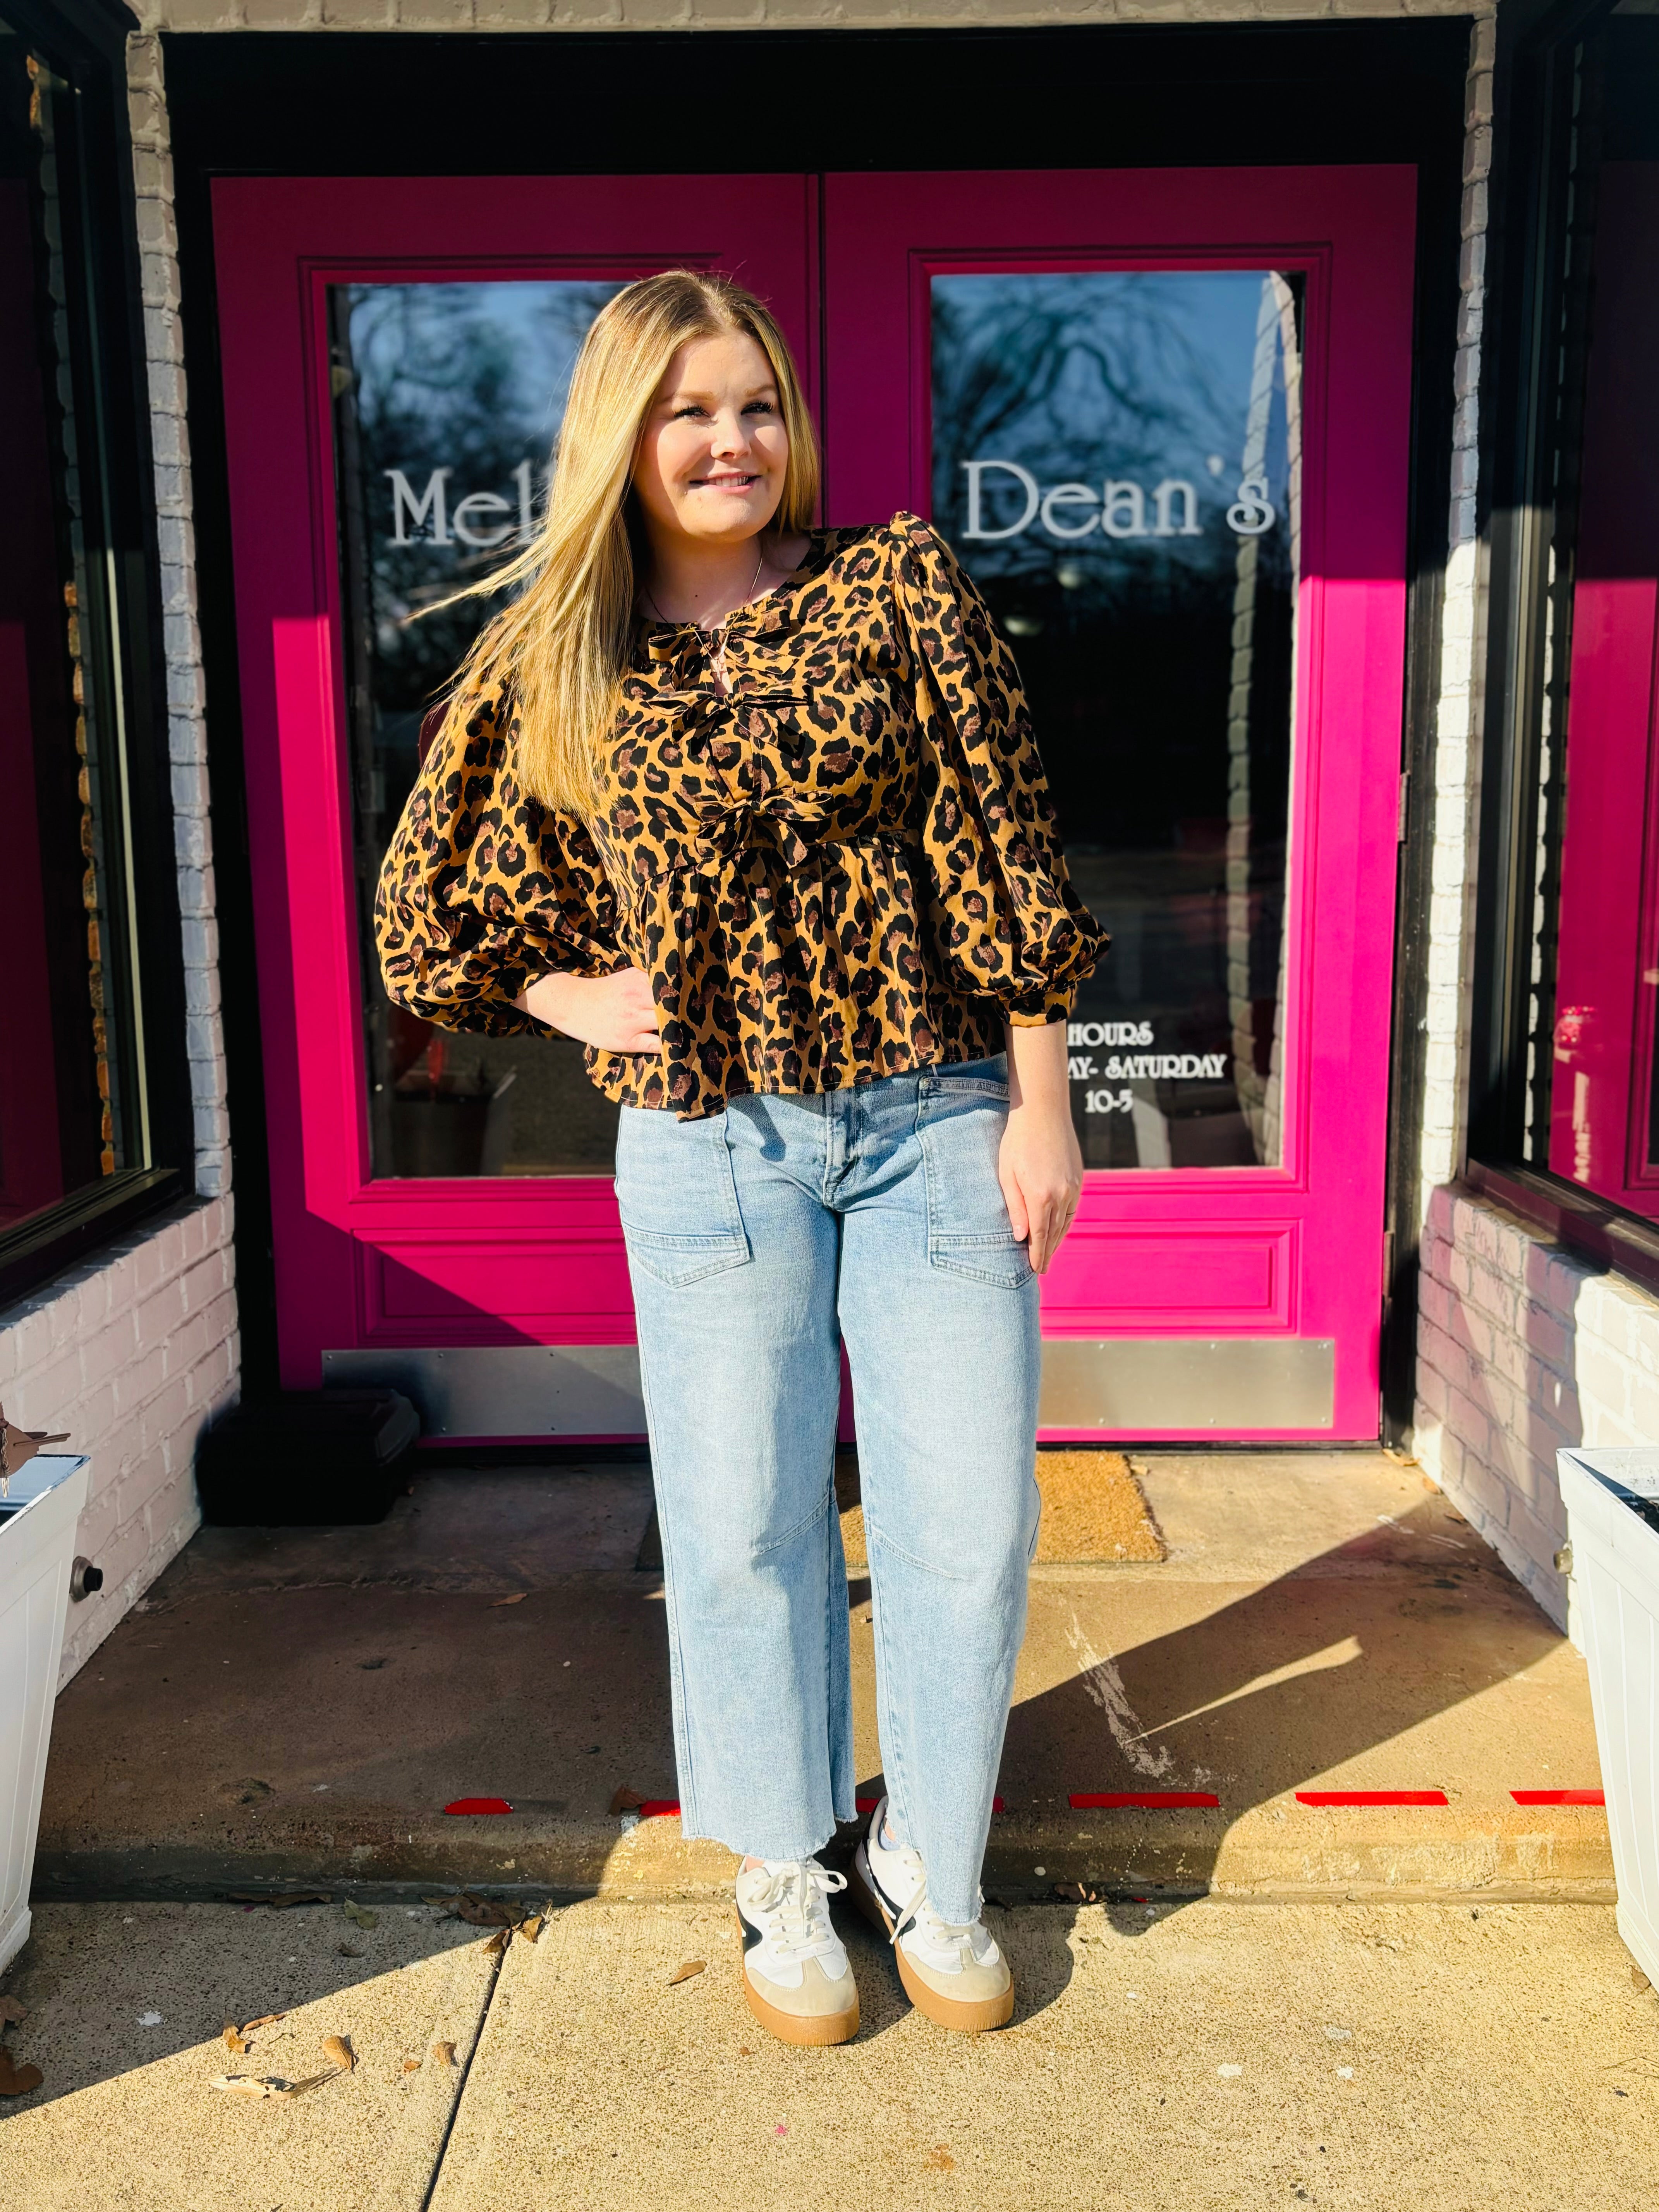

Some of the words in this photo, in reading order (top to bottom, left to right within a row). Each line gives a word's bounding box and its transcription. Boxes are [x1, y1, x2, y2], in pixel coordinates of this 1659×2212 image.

[961, 454, 1275, 539] Dean's
[1067, 1021, 1154, 1046] HOURS
[1068, 1056, 1099, 1080] AY-
[1104, 1054, 1227, 1080] SATURDAY
[1085, 1089, 1132, 1113] 10-5
